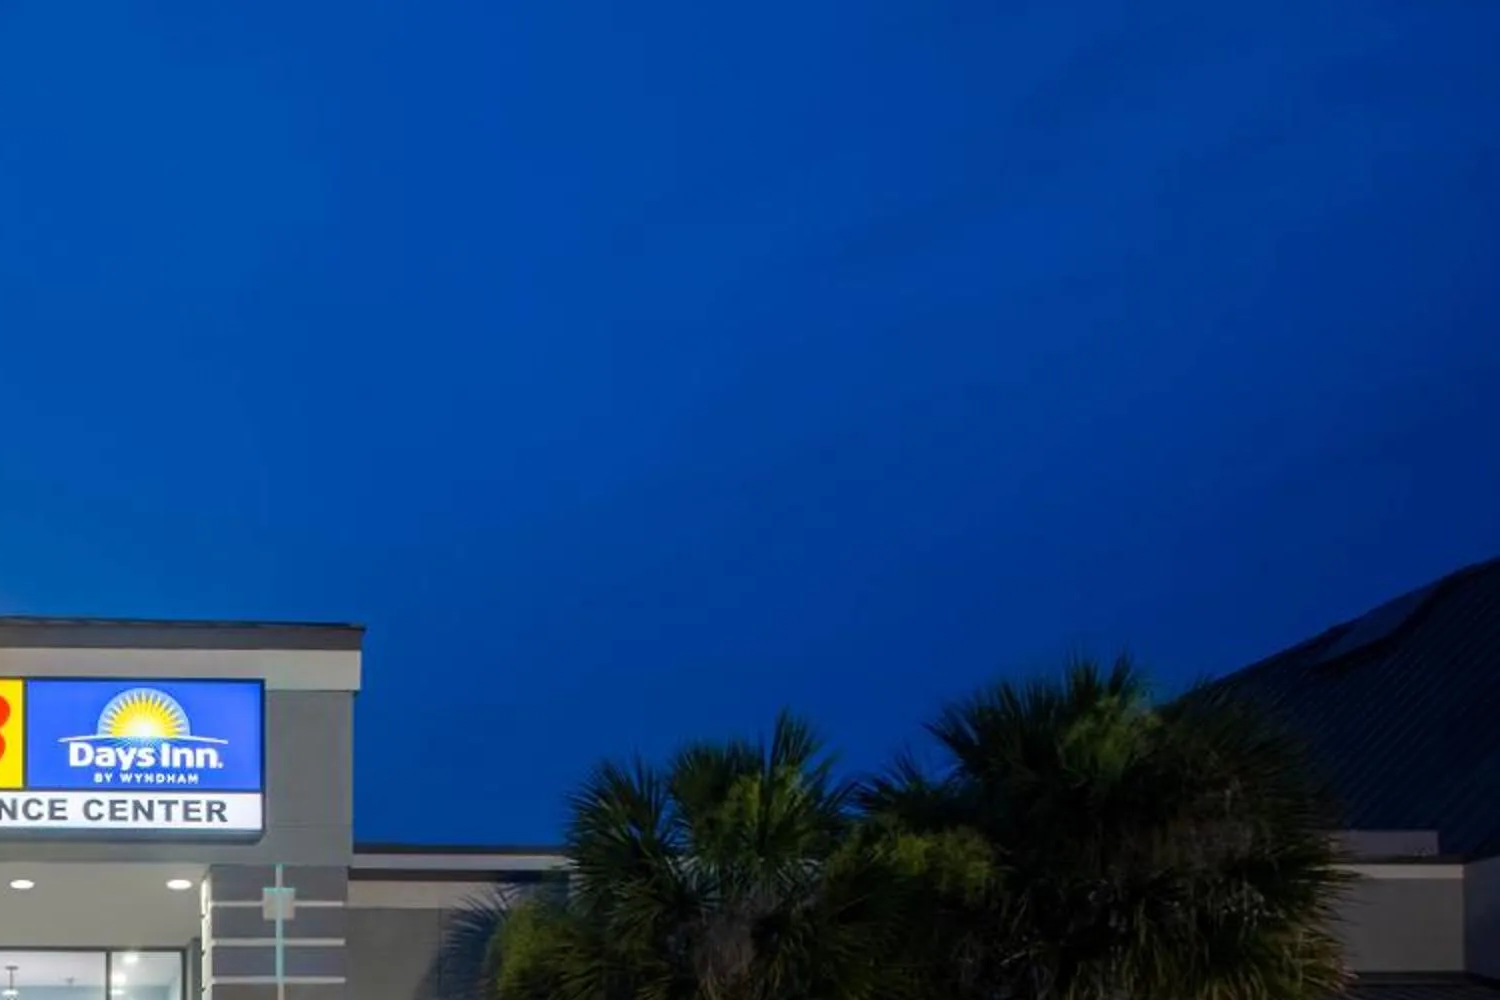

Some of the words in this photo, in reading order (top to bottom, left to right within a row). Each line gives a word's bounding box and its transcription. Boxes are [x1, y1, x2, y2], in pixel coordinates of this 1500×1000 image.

[69, 742, 155, 770] Days
[94, 773, 112, 783] BY
[120, 773, 199, 784] WYNDHAM
[83, 799, 228, 823] CENTER
